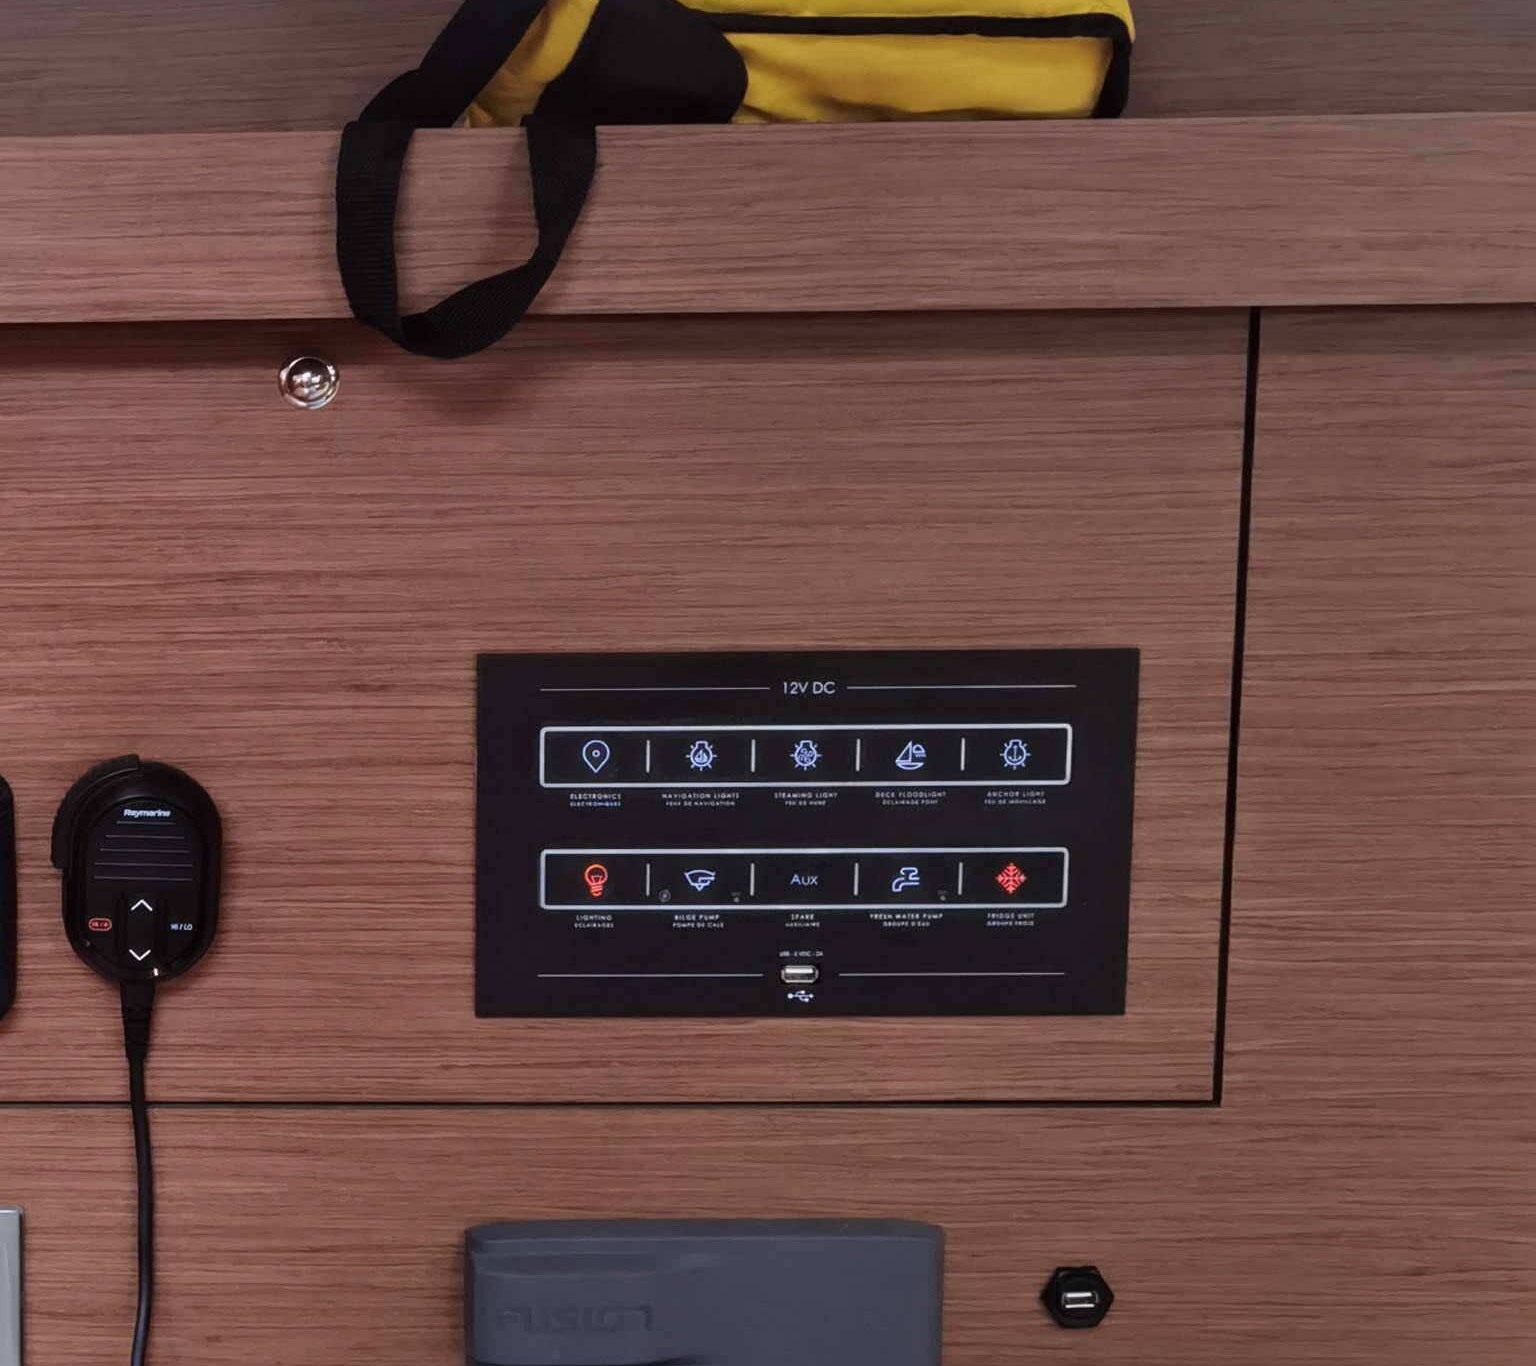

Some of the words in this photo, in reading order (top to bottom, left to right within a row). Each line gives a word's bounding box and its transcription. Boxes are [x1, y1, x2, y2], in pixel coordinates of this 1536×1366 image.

[782, 681, 809, 695] 12V
[812, 681, 836, 695] DC
[661, 792, 711, 800] NAVIGATION
[123, 808, 171, 818] Raymarine
[496, 1304, 654, 1334] FUSION
